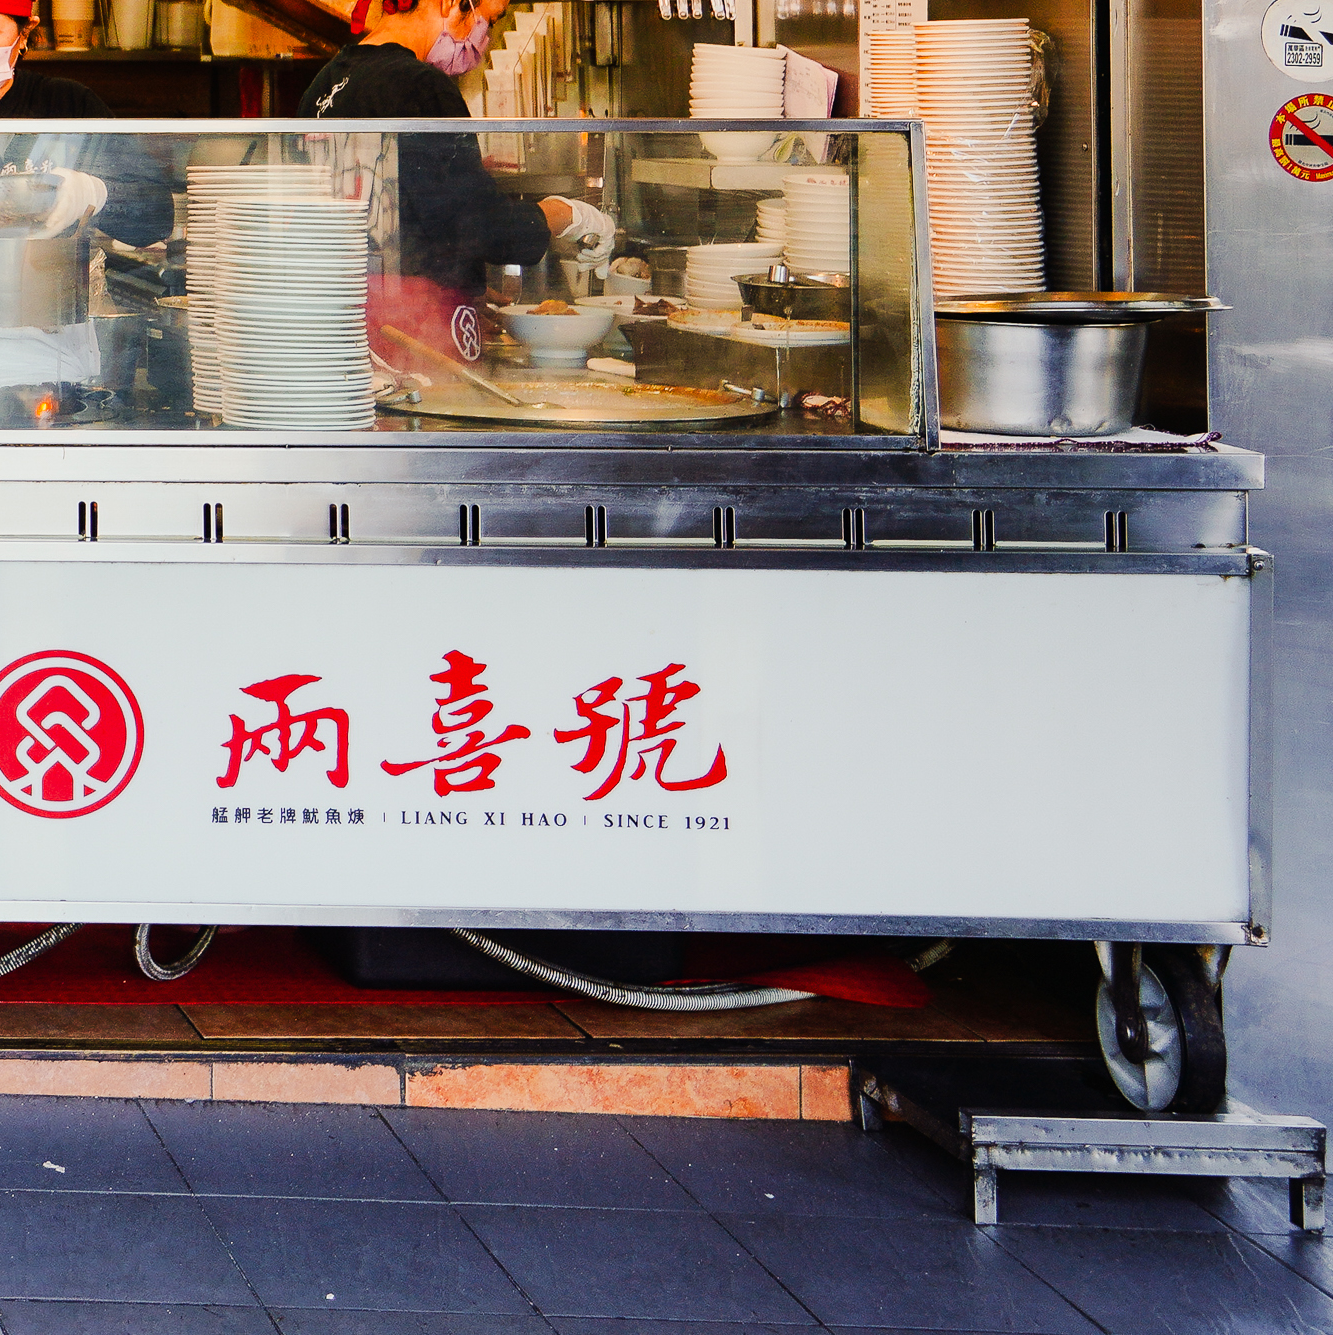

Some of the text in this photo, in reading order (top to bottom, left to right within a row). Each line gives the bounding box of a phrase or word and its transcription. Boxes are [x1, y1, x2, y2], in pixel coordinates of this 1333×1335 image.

[1286, 52, 1321, 65] 2302-2959
[216, 648, 728, 802] 兩喜號
[210, 806, 366, 826] 艋舺老牌魷魚焿
[400, 810, 569, 828] LIANG XI HAO
[603, 813, 732, 831] SINCE 1921
